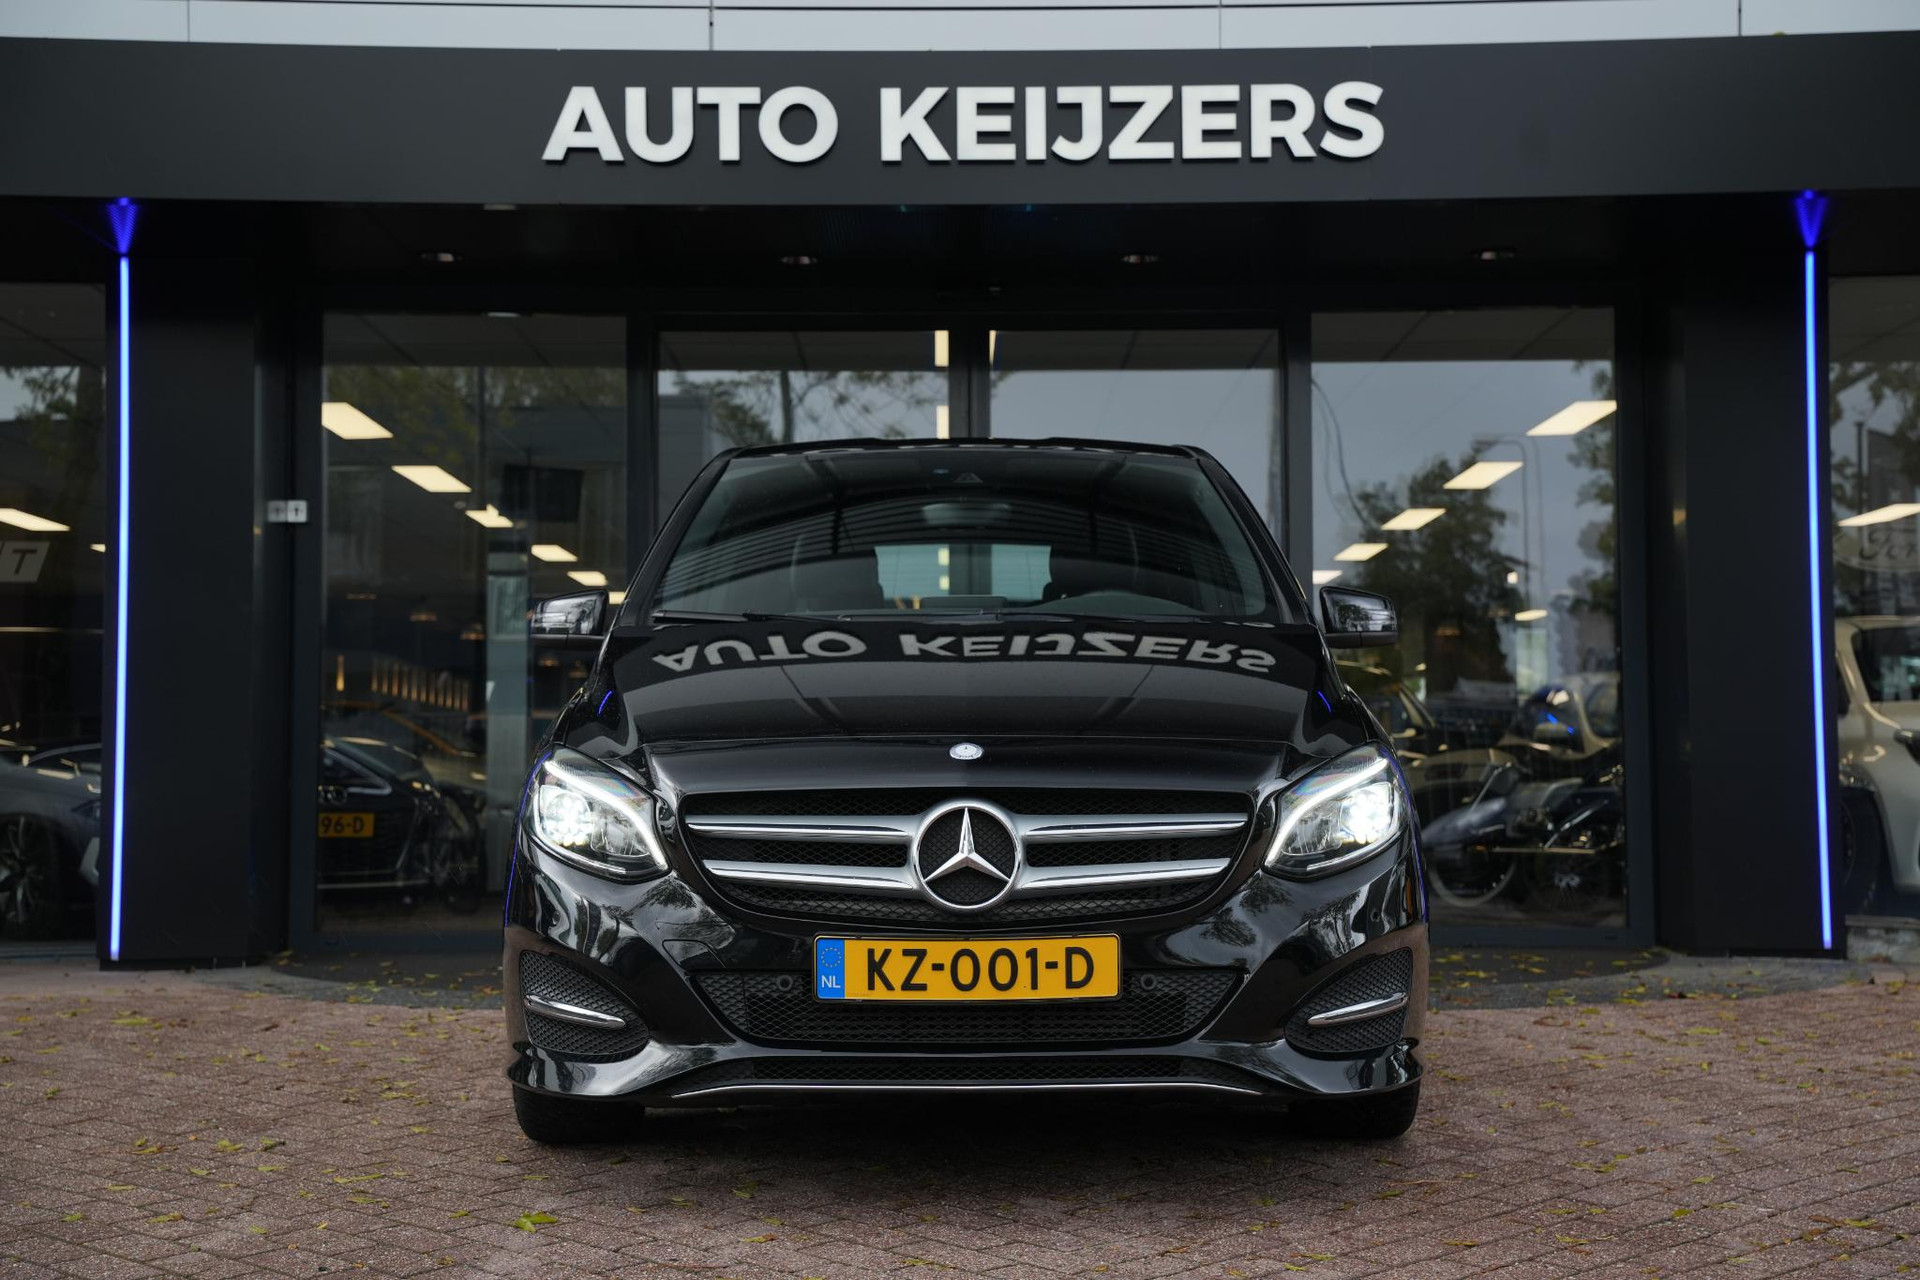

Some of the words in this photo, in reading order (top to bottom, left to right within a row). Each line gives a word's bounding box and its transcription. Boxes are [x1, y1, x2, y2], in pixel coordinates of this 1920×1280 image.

[542, 86, 839, 162] AUTO
[880, 81, 1385, 161] KEIJZERS
[821, 975, 841, 989] NL
[866, 946, 1094, 991] KZ-001-D
